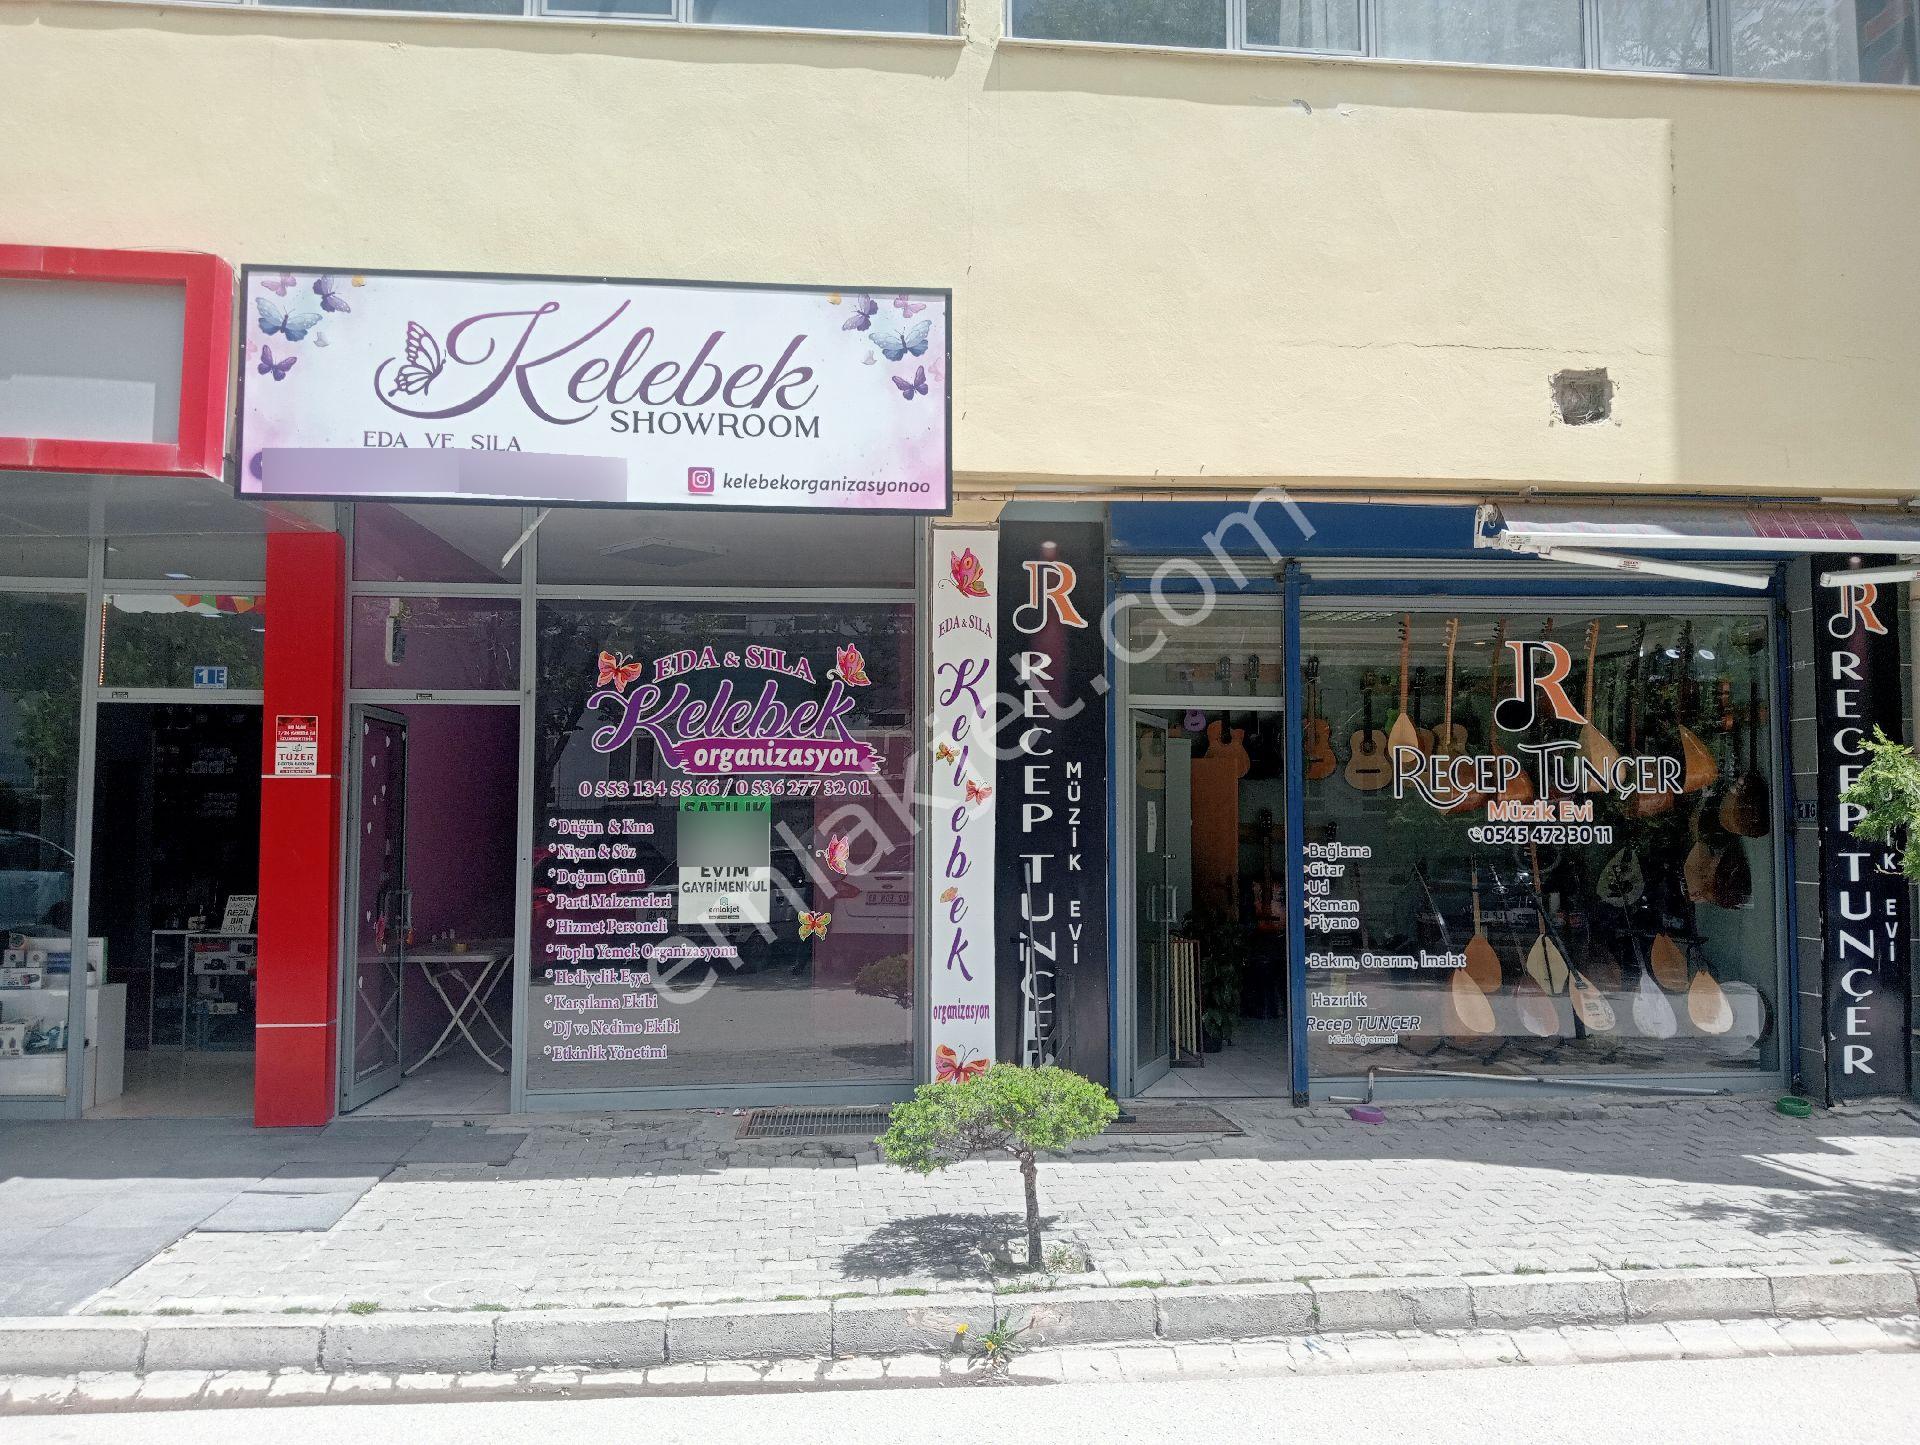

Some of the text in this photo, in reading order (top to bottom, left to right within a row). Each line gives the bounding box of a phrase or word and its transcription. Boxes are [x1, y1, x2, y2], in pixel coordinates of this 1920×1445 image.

[374, 299, 819, 426] Kelebek
[609, 408, 821, 439] SHOWROOM
[363, 430, 522, 452] EDA VE SILA
[723, 471, 931, 497] kelebekorganizasyonoo
[937, 615, 961, 638] EDA
[968, 614, 993, 639] SILA
[653, 645, 816, 684] EDA & SILA
[587, 679, 856, 769] Kelebek
[1019, 651, 1054, 833] RECEP
[693, 740, 859, 772] organizasyon
[1393, 740, 1684, 810] RECEP TUNÇER
[579, 778, 871, 800] 0 553 134 55 66 / 0 536 277 32 01
[937, 658, 990, 982] Kelebek
[1487, 800, 1593, 823] Müzik Evi
[558, 818, 654, 838] Düğün & Kına
[1482, 825, 1612, 845] 0545 472 30 11
[557, 843, 636, 863] Nişan & Söz
[1308, 842, 1372, 861] Bağlama
[556, 868, 645, 888] Doğum Günü
[1308, 862, 1345, 877] Gitar
[681, 878, 768, 893] GAYRİMENKUL
[1308, 880, 1329, 895] Ud
[556, 892, 672, 909] Parti Malzemeleri
[1308, 899, 1360, 913] Keman
[555, 917, 668, 935] Hizmet Personeli
[1309, 915, 1360, 932] Piyano
[556, 943, 738, 964] Toplu Yemek Organizasyonu
[1309, 949, 1467, 969] Bakım, Onarım, İmalat
[1838, 853, 1876, 1075] TUNÇER
[554, 969, 650, 988] Hediyelik Eşya
[554, 993, 659, 1014] Karşılama Ekibi
[1311, 991, 1368, 1008] Hazırlık
[933, 997, 990, 1024] organizasyon
[552, 1018, 680, 1040] DJ ve Nedime Ekibi
[1306, 1015, 1422, 1034] Recep TUNÇER
[552, 1044, 668, 1061] Etkinlik Yönetimi
